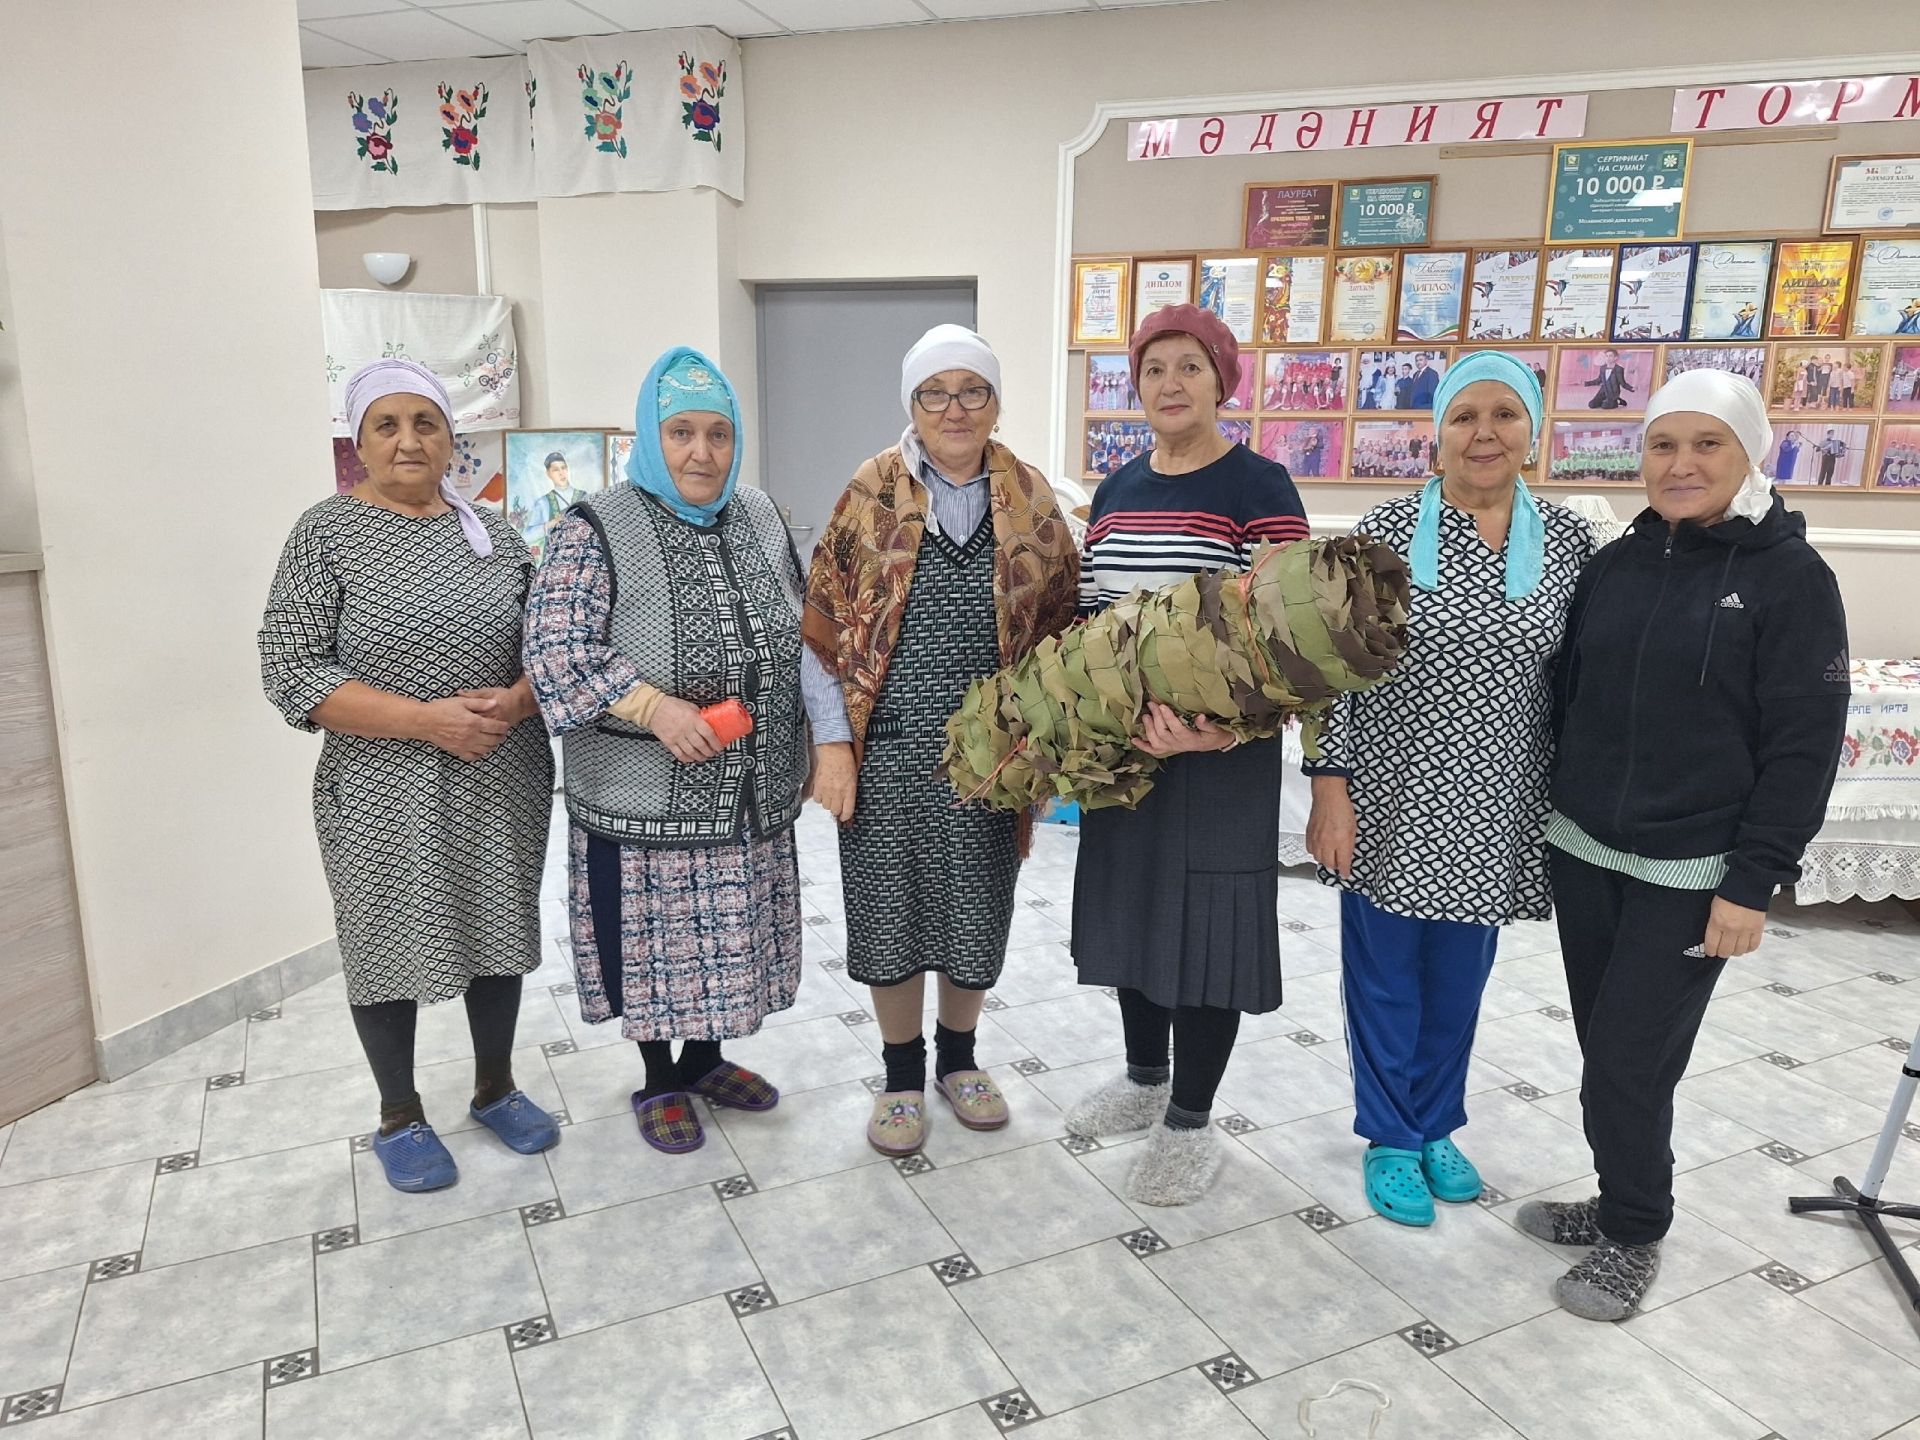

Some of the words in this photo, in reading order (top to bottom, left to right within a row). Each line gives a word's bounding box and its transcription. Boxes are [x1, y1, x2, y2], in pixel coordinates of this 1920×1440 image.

[1139, 97, 1563, 159] МӘДӘНИЯТ
[1597, 154, 1649, 163] СЕРТИФИКАТ
[1612, 163, 1645, 172] СУММУ
[1576, 177, 1600, 195] 10
[1605, 175, 1645, 194] 000
[1277, 189, 1319, 199] ЛАУРЕАТ
[1359, 204, 1375, 216] 10
[1378, 203, 1404, 215] 000
[1145, 280, 1182, 289] ДИПЛОМ
[1408, 282, 1456, 293] ДИПЛОМ
[1720, 601, 1744, 609] adidas
